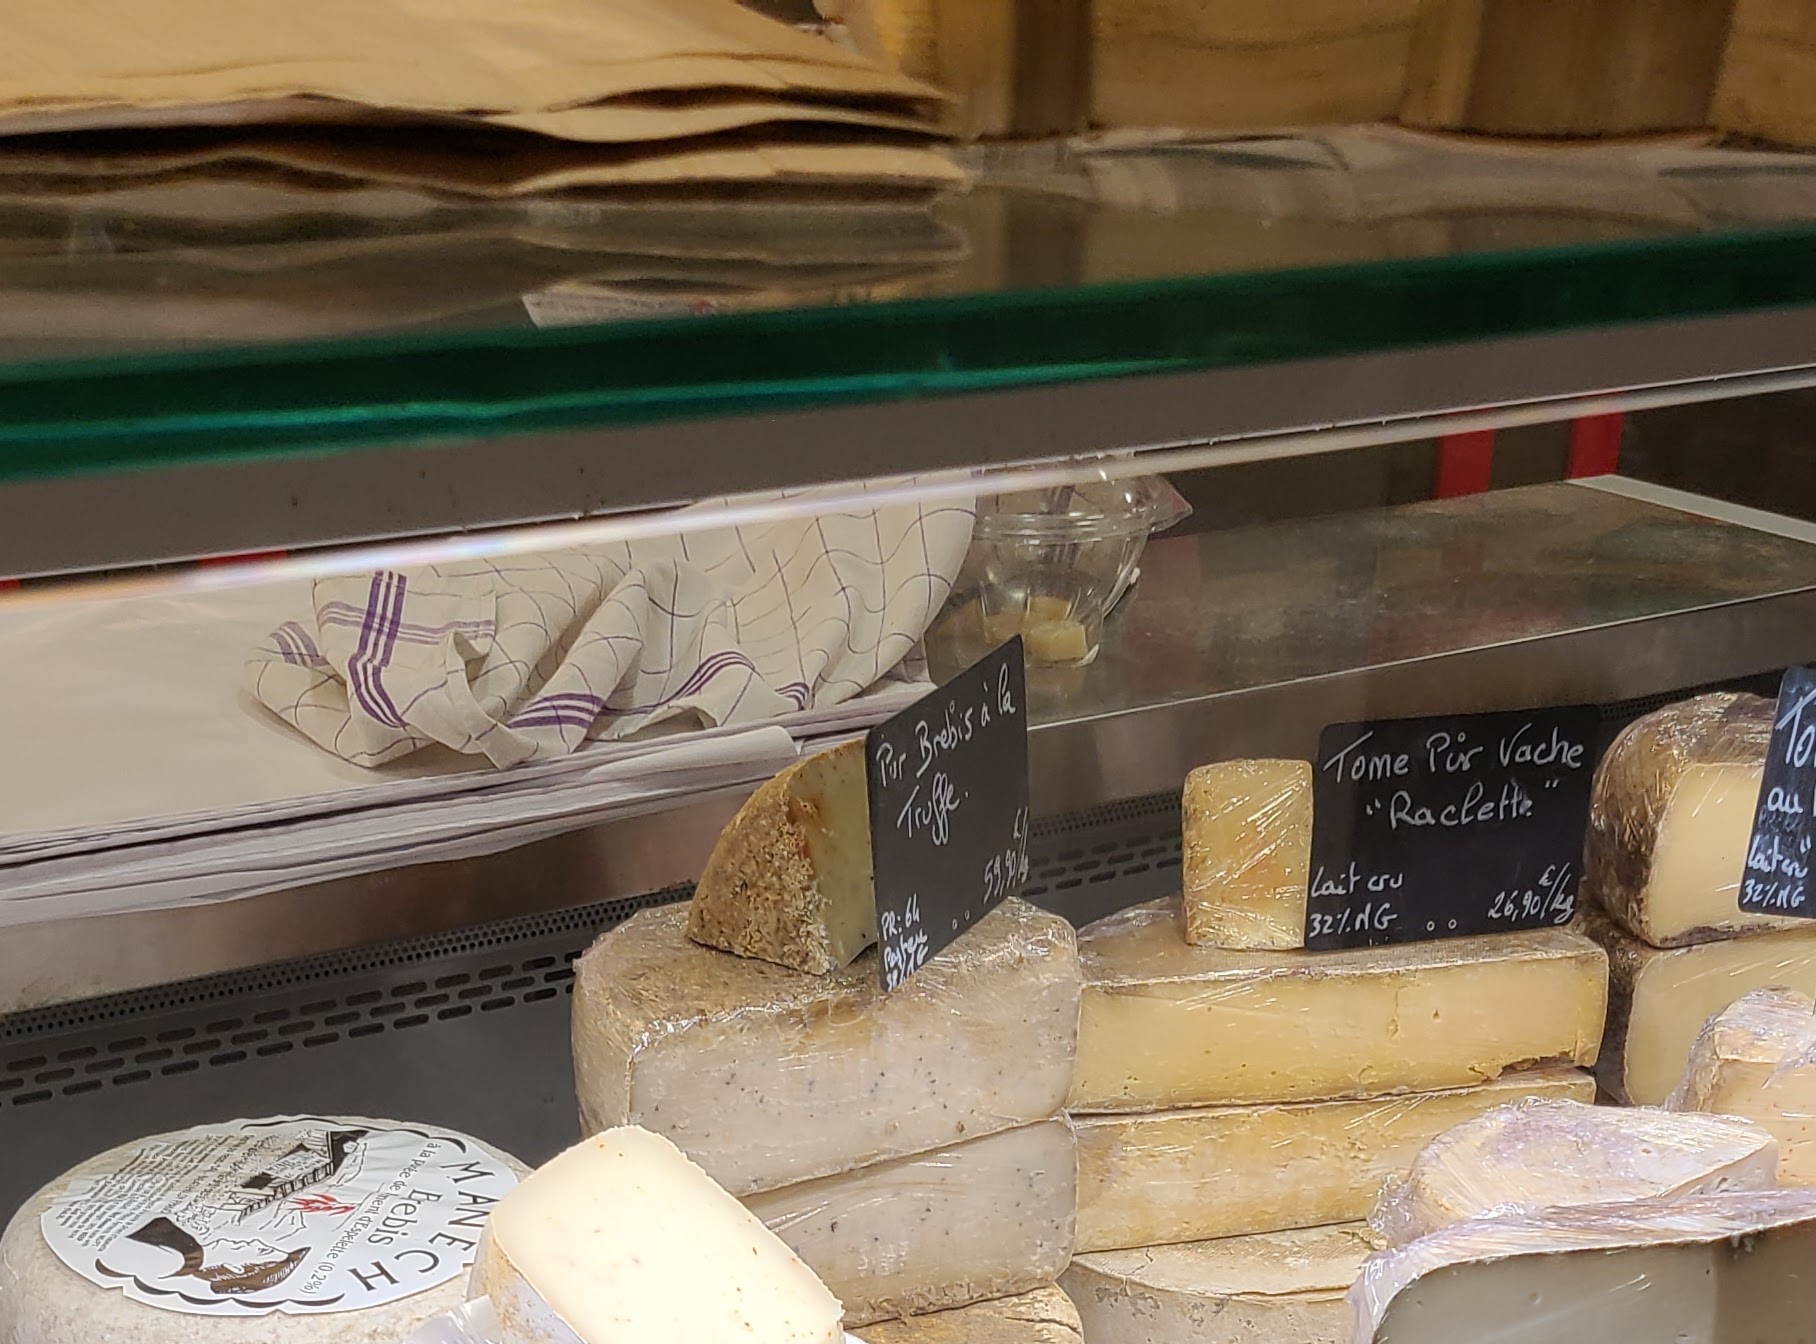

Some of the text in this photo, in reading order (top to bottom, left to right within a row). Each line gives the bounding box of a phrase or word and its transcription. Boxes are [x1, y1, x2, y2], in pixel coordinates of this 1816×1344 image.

[876, 741, 906, 787] Pur
[915, 706, 973, 779] Brebis
[998, 662, 1016, 715] la
[1323, 723, 1584, 783] Tome Pur Vache
